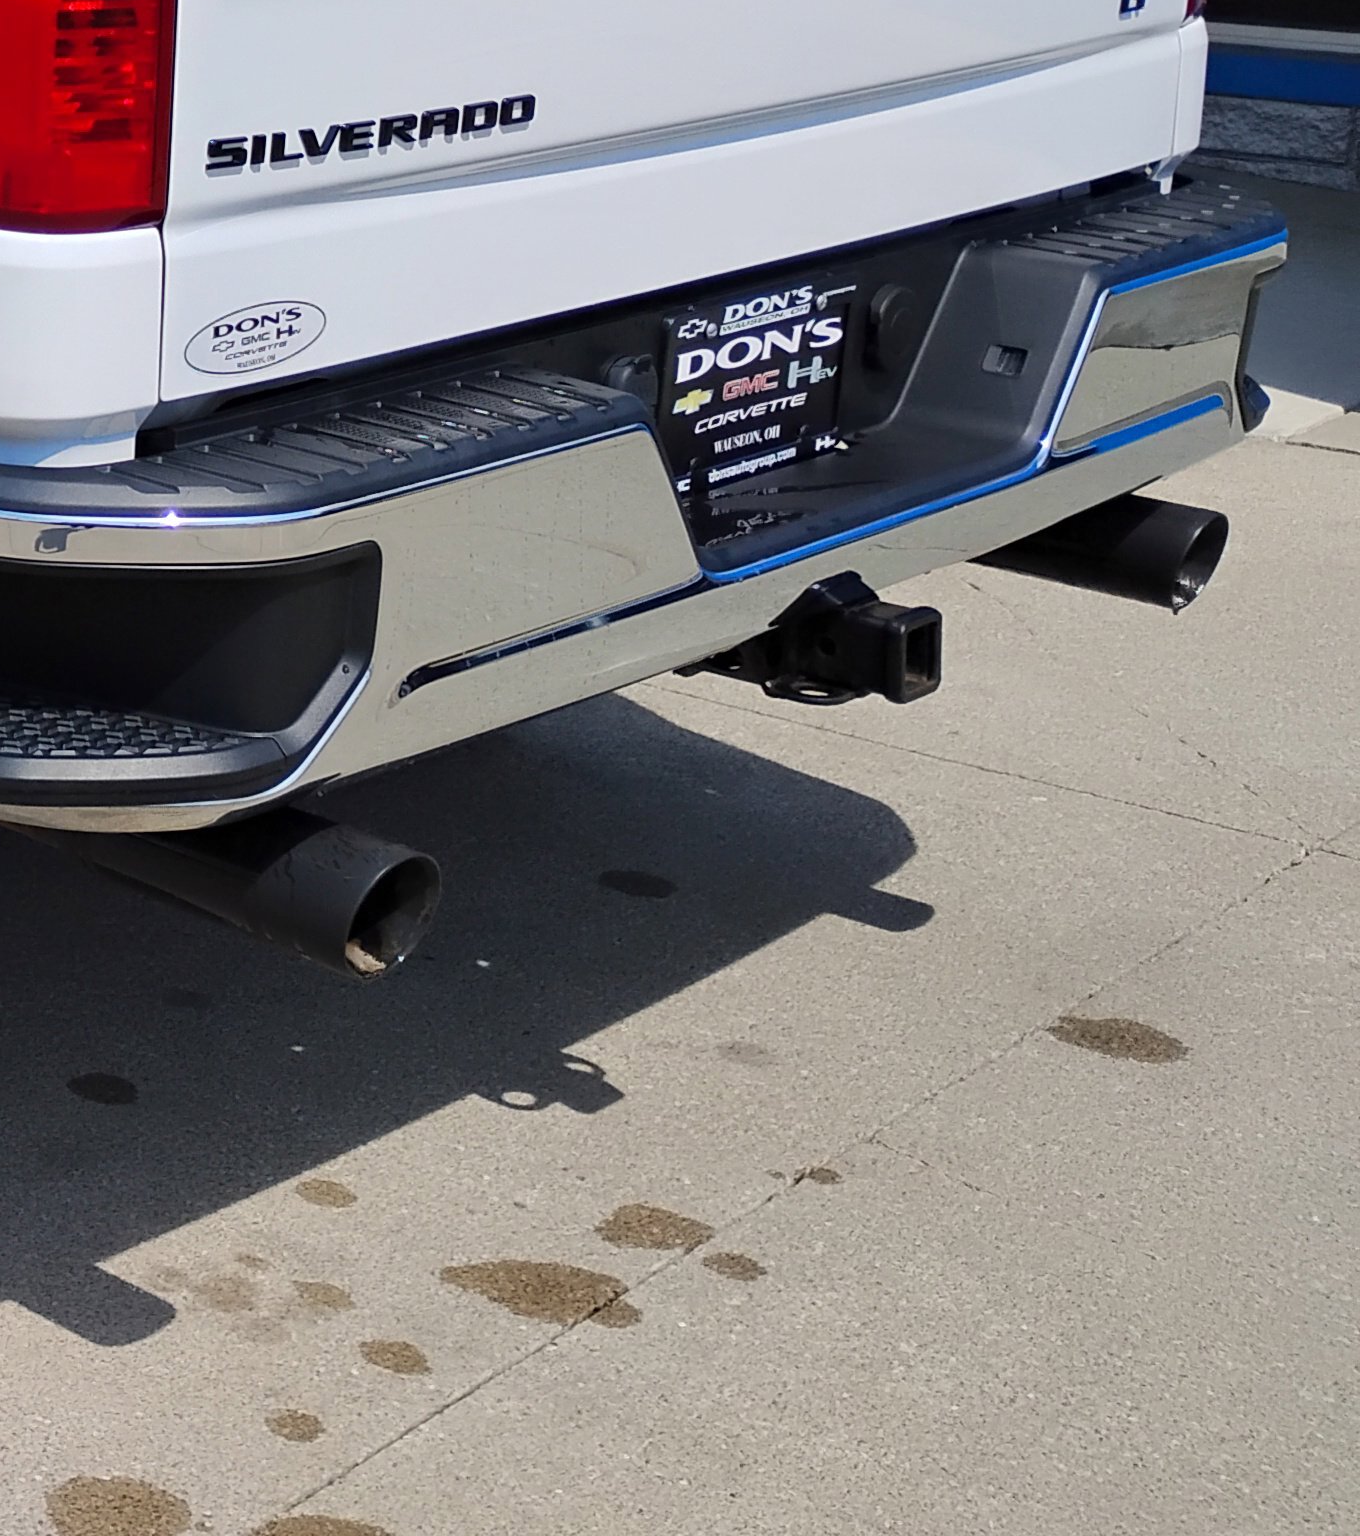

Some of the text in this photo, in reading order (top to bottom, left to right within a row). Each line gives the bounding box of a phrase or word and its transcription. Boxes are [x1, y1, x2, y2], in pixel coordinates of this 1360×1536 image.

[205, 94, 537, 171] SILVERADO
[212, 307, 302, 339] DON'S
[723, 285, 813, 324] DON'S
[241, 332, 270, 346] GMC
[675, 317, 844, 384] DON'S
[723, 369, 780, 401] GMC
[694, 392, 808, 434] CORVETTE
